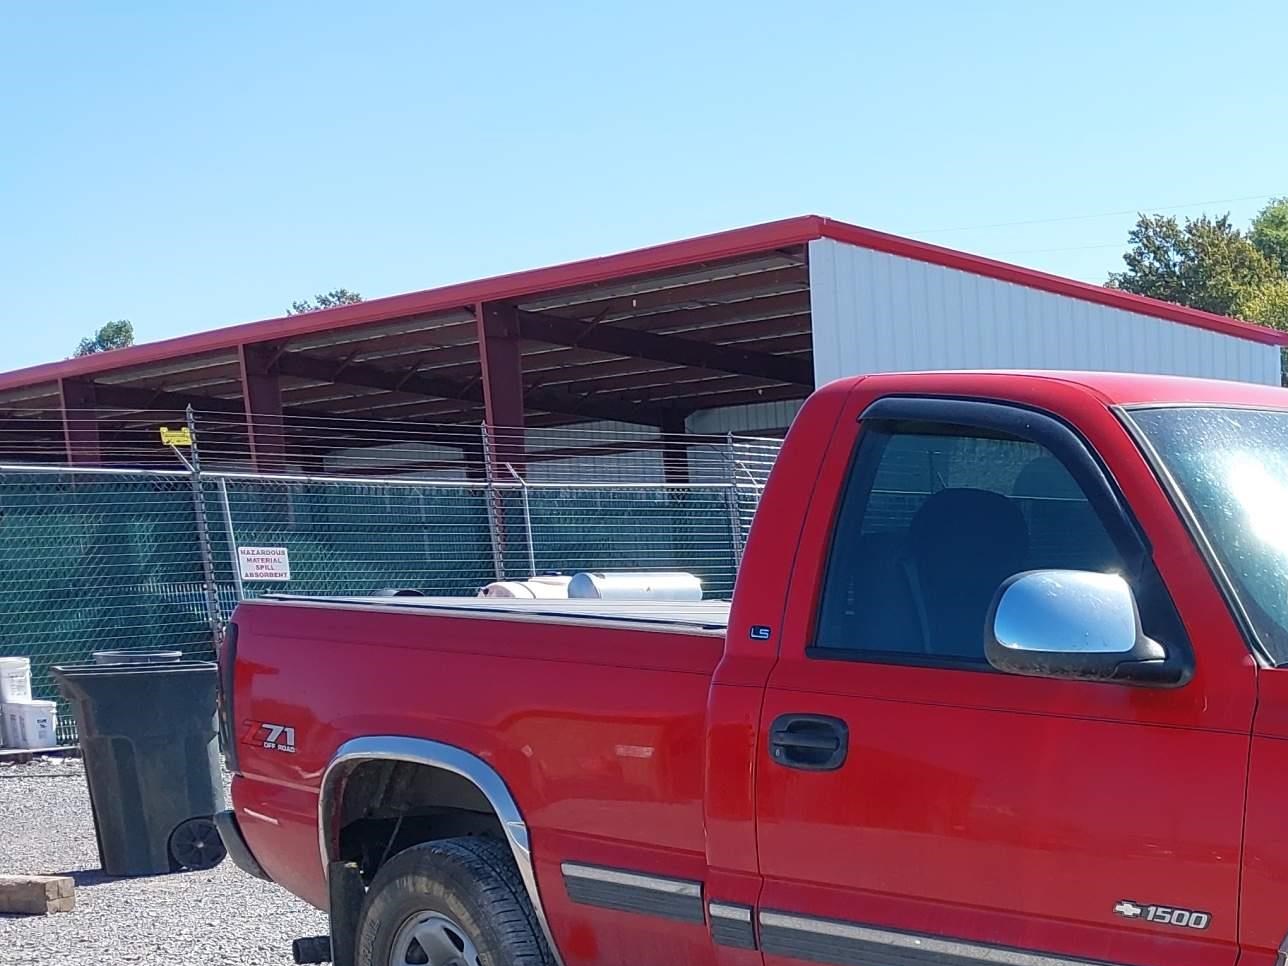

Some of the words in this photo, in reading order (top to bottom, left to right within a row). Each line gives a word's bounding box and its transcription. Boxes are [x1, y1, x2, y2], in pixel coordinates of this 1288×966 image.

[751, 627, 769, 639] LS
[241, 719, 296, 747] Z71
[263, 741, 276, 750] OFF
[277, 744, 297, 753] ROAD
[1146, 905, 1208, 929] 1500
